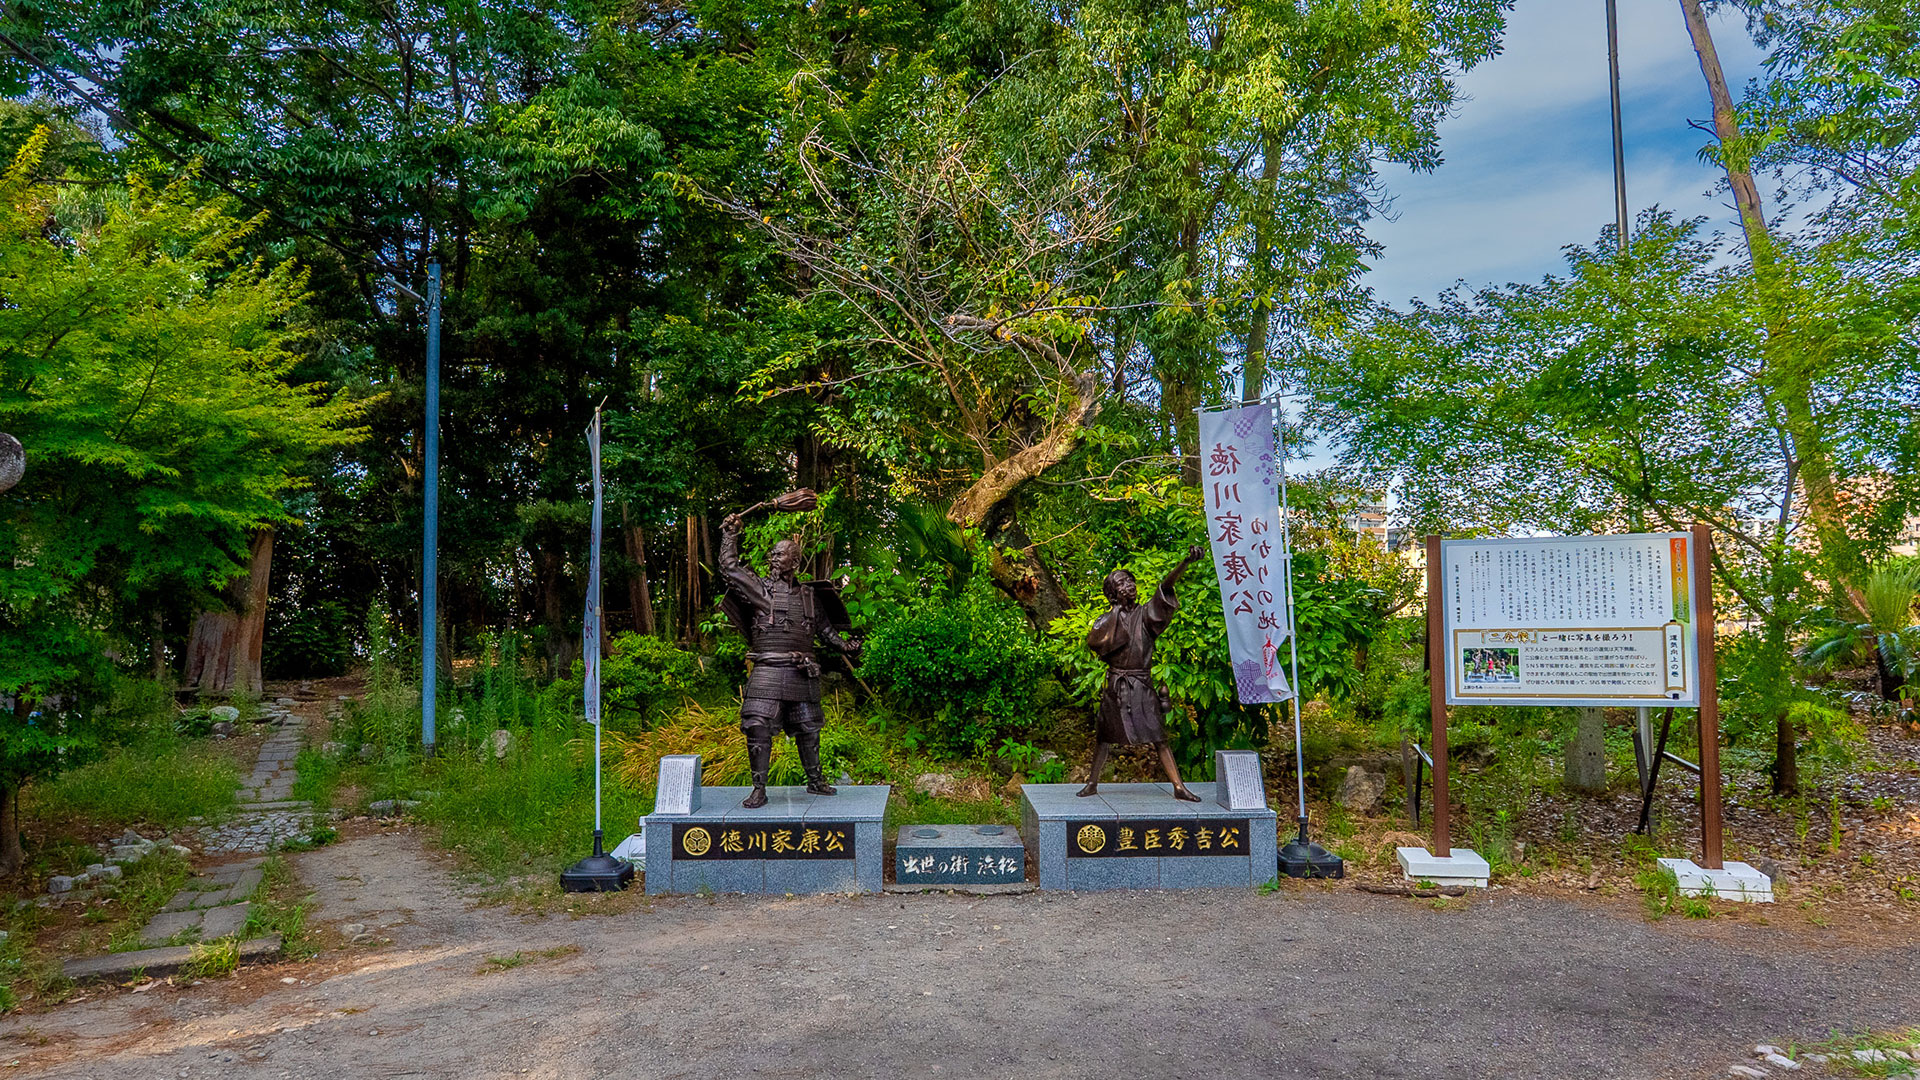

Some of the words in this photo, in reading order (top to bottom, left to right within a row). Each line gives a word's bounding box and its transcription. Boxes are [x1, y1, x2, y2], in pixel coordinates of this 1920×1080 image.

[720, 828, 846, 854] 徳川家康公
[1116, 825, 1240, 851] 豊臣秀吉公
[902, 854, 968, 876] 出世の街
[977, 854, 1018, 876] 浜松
